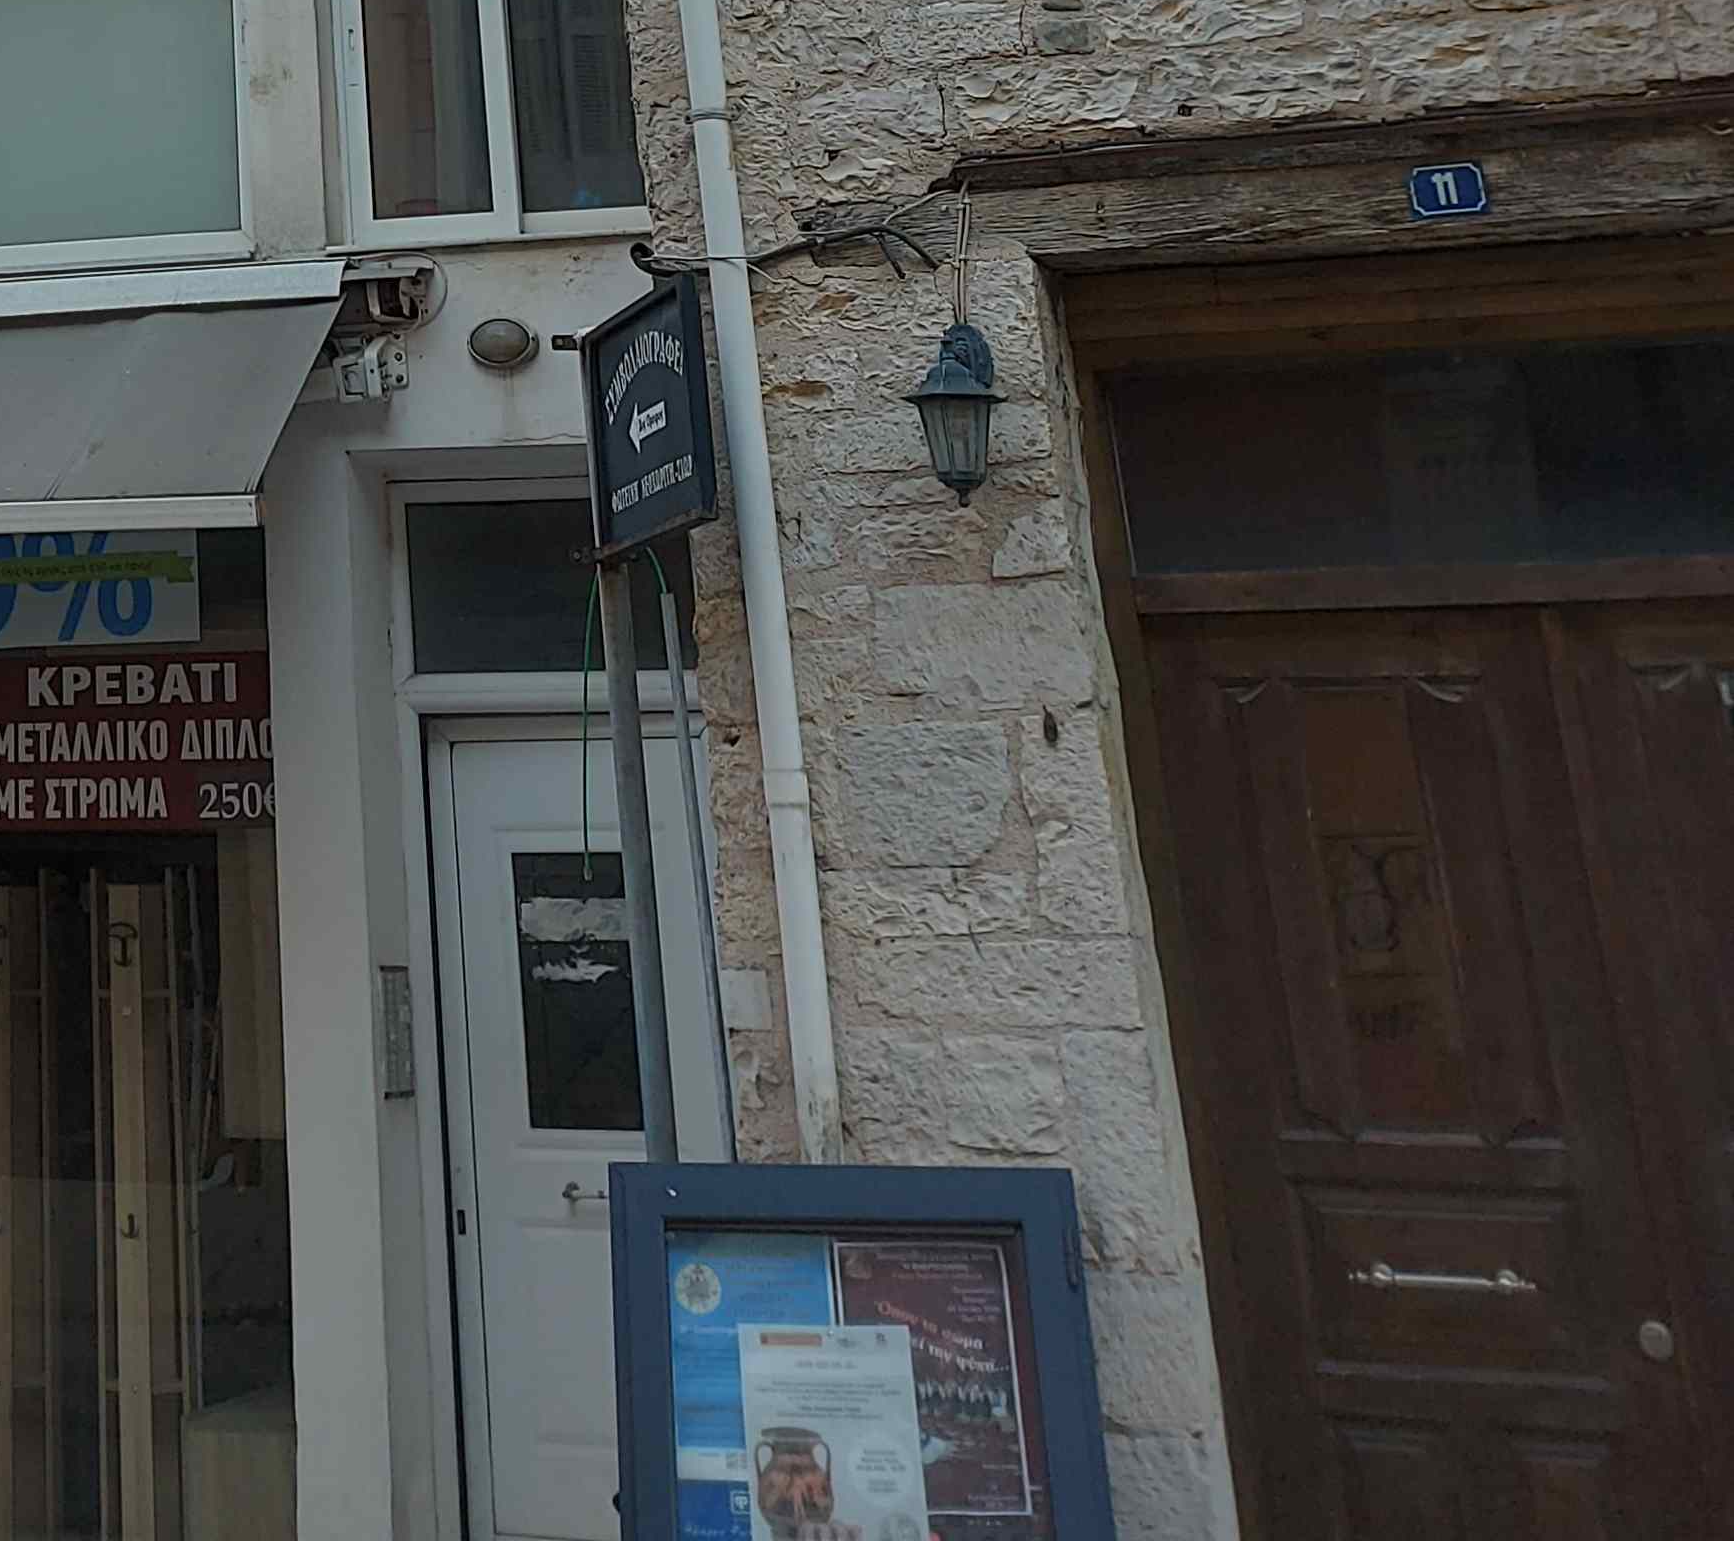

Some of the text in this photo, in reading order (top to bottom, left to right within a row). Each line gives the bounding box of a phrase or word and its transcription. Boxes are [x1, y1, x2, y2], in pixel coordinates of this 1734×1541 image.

[1429, 170, 1459, 206] 11
[26, 662, 238, 707] ΚΡΕΒΑΤΙ
[43, 776, 169, 820] ΣΤΡΩΜΑ
